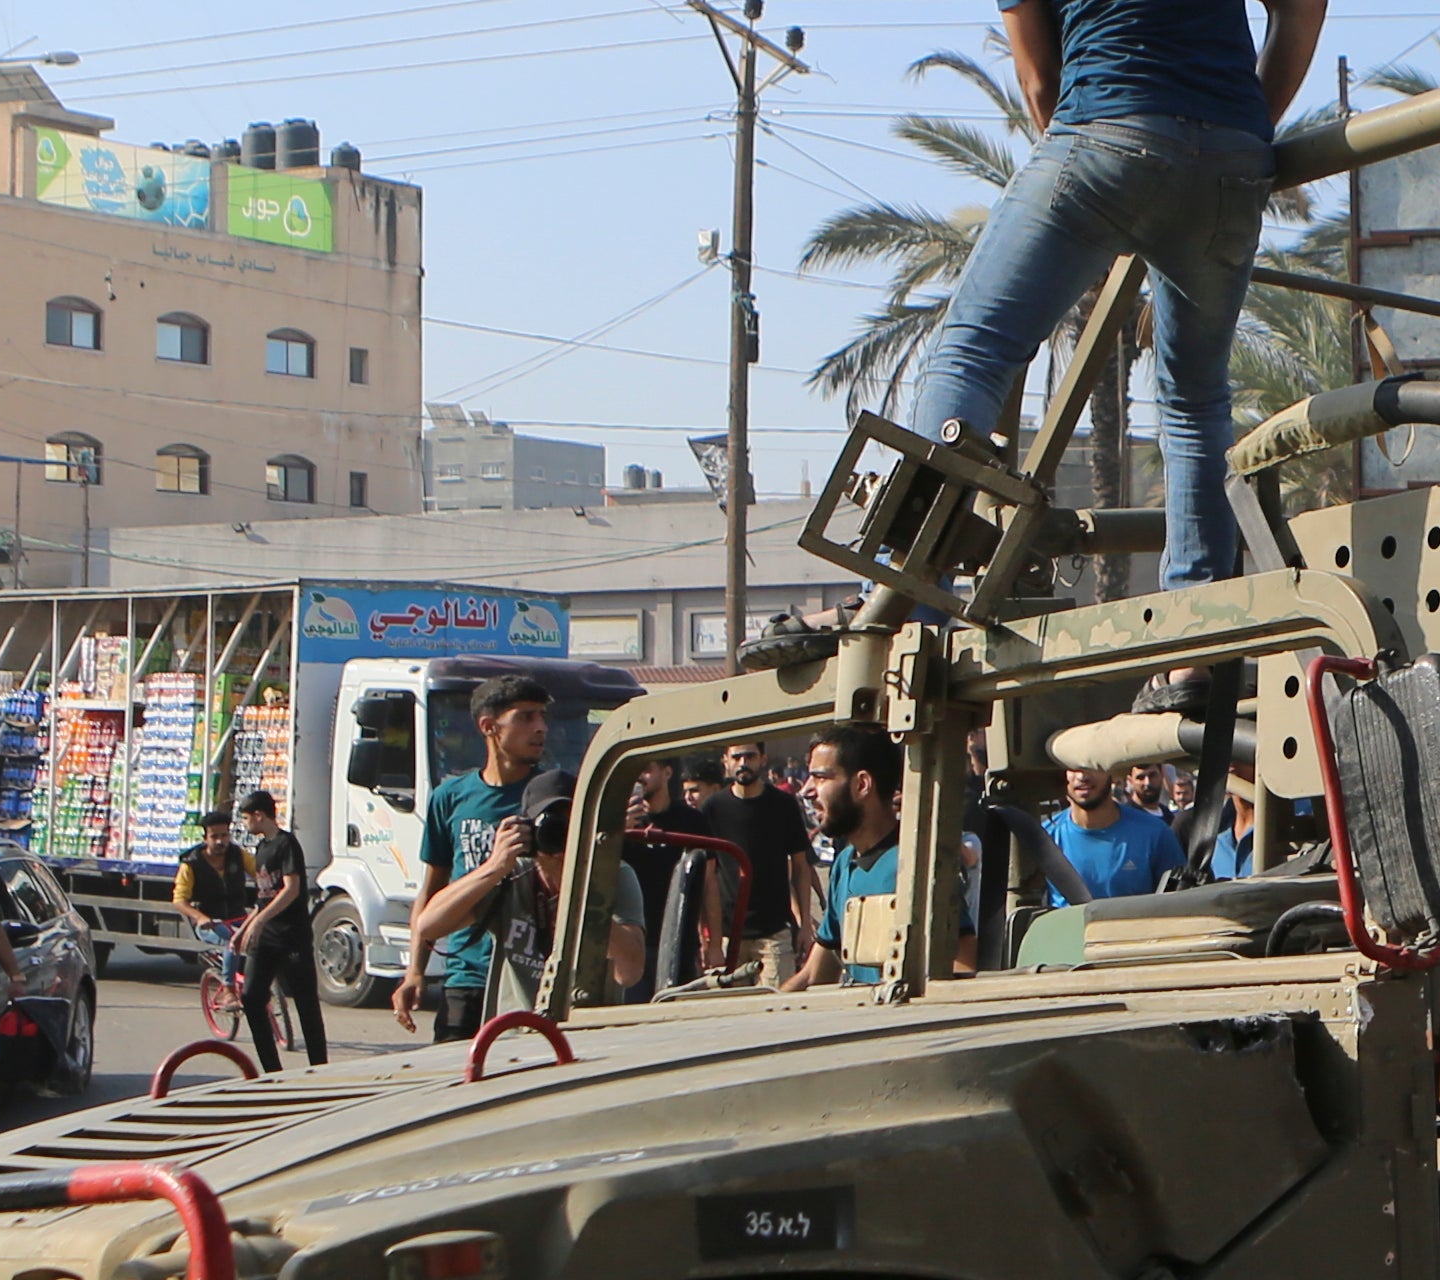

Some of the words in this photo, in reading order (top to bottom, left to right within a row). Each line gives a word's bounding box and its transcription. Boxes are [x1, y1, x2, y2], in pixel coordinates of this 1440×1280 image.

[242, 196, 280, 220] جوال
[195, 252, 235, 271] شباب
[238, 259, 277, 274] نادي
[368, 596, 498, 642] الفالوجي
[303, 622, 359, 638] الفالوجي
[510, 629, 561, 645] الفالوجي
[745, 1211, 774, 1237] 35
